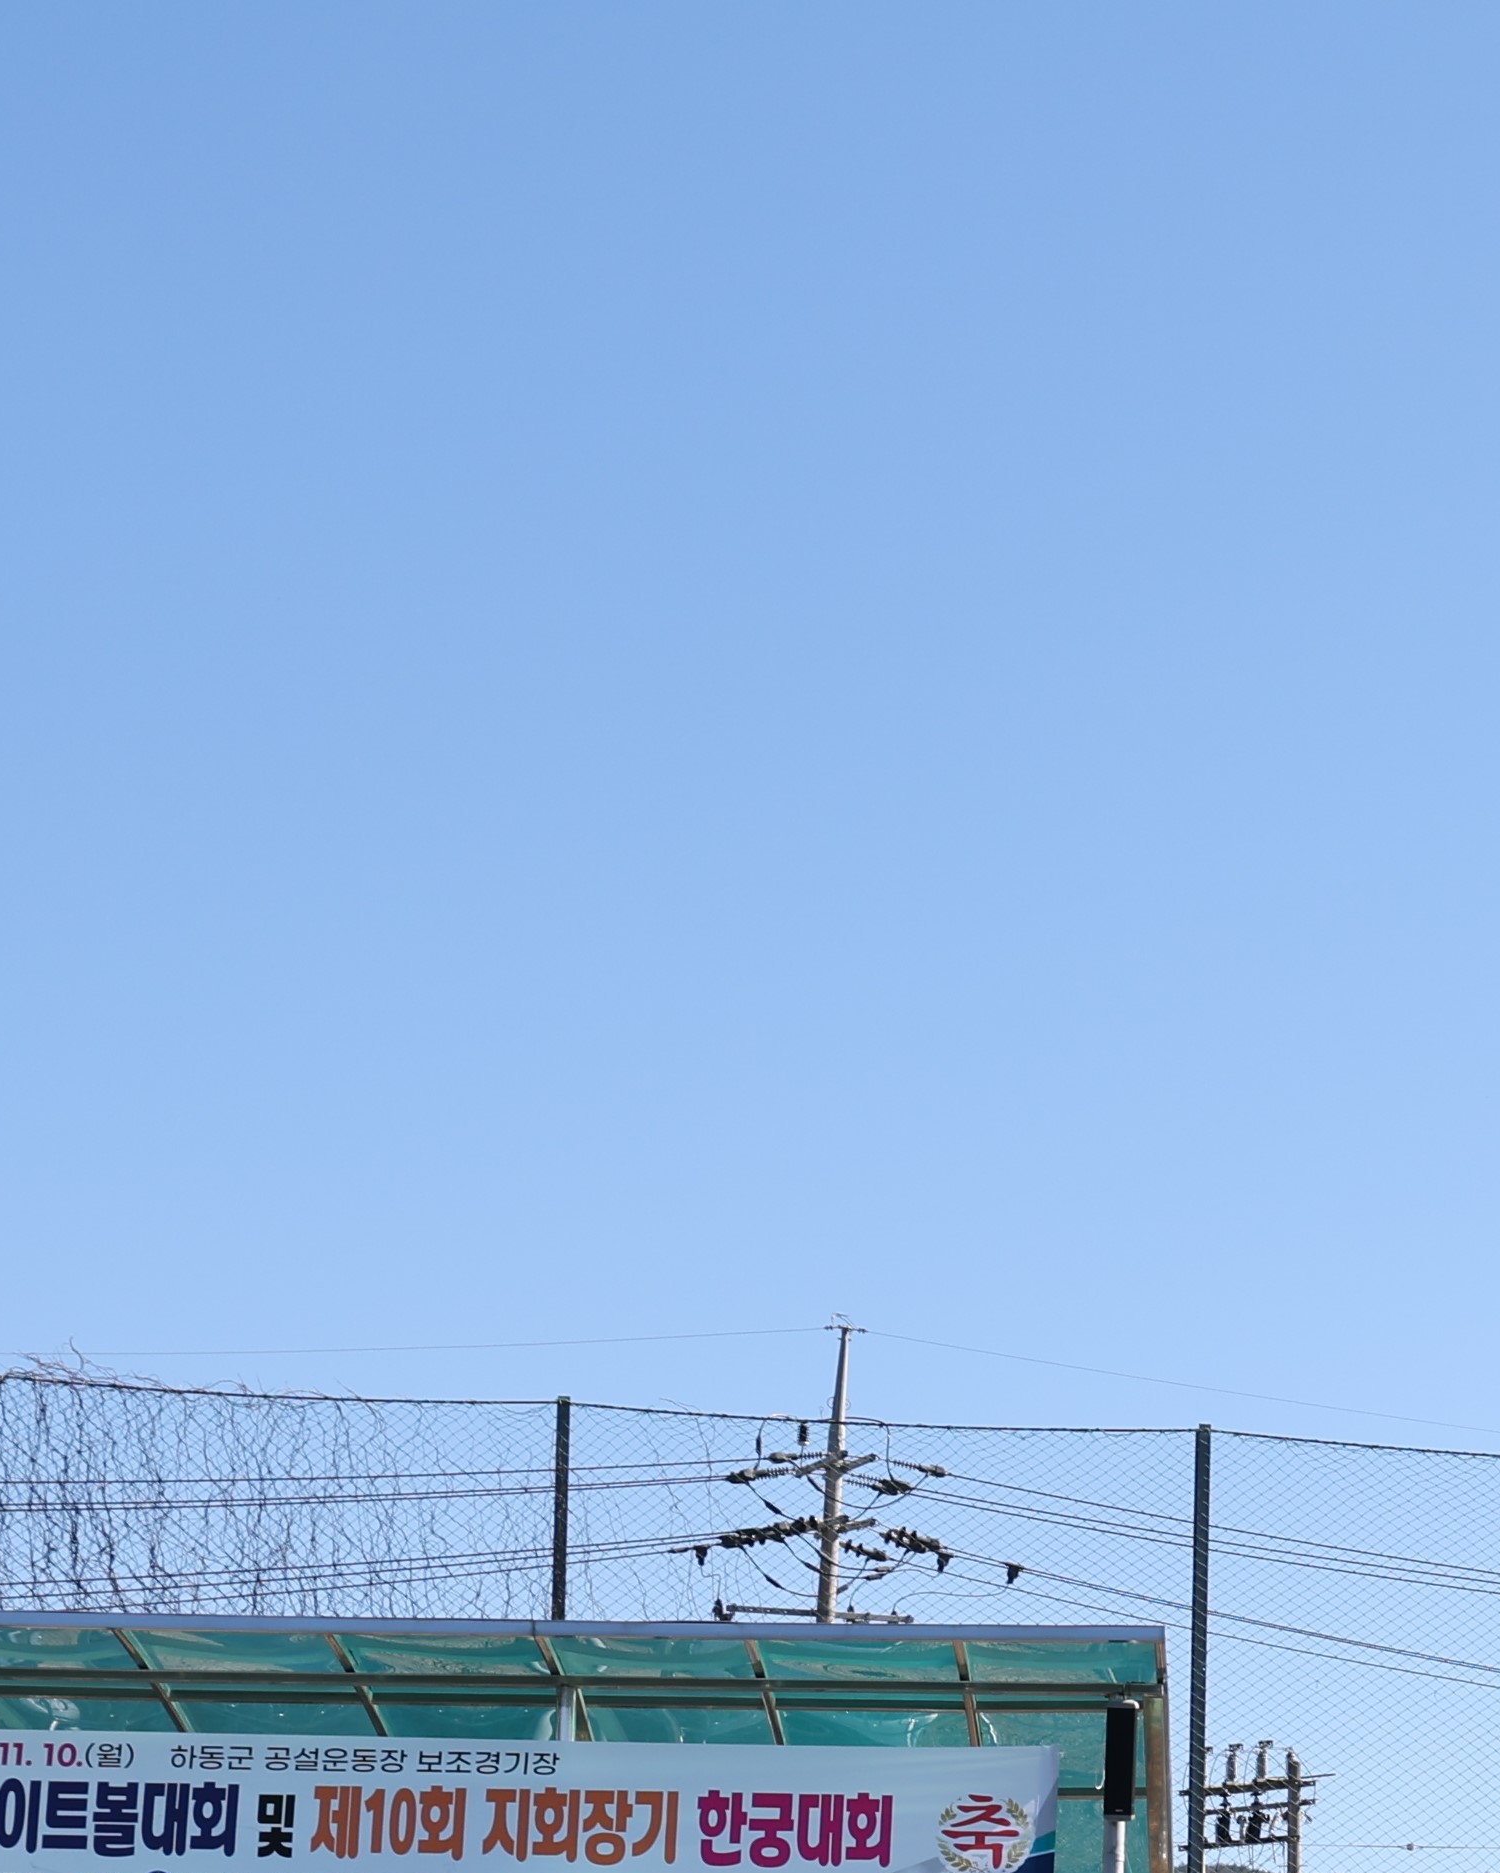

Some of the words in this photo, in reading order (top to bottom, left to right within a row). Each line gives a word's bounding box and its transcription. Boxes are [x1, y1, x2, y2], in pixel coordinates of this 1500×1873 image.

[170, 1745, 254, 1771] 하동군
[264, 1746, 408, 1774] 공설운동장
[416, 1750, 561, 1776] 보조경기장
[256, 1793, 296, 1859] 및
[310, 1785, 467, 1861] 제10회
[482, 1787, 679, 1866] 지회장기
[697, 1789, 893, 1868] 한궁대회
